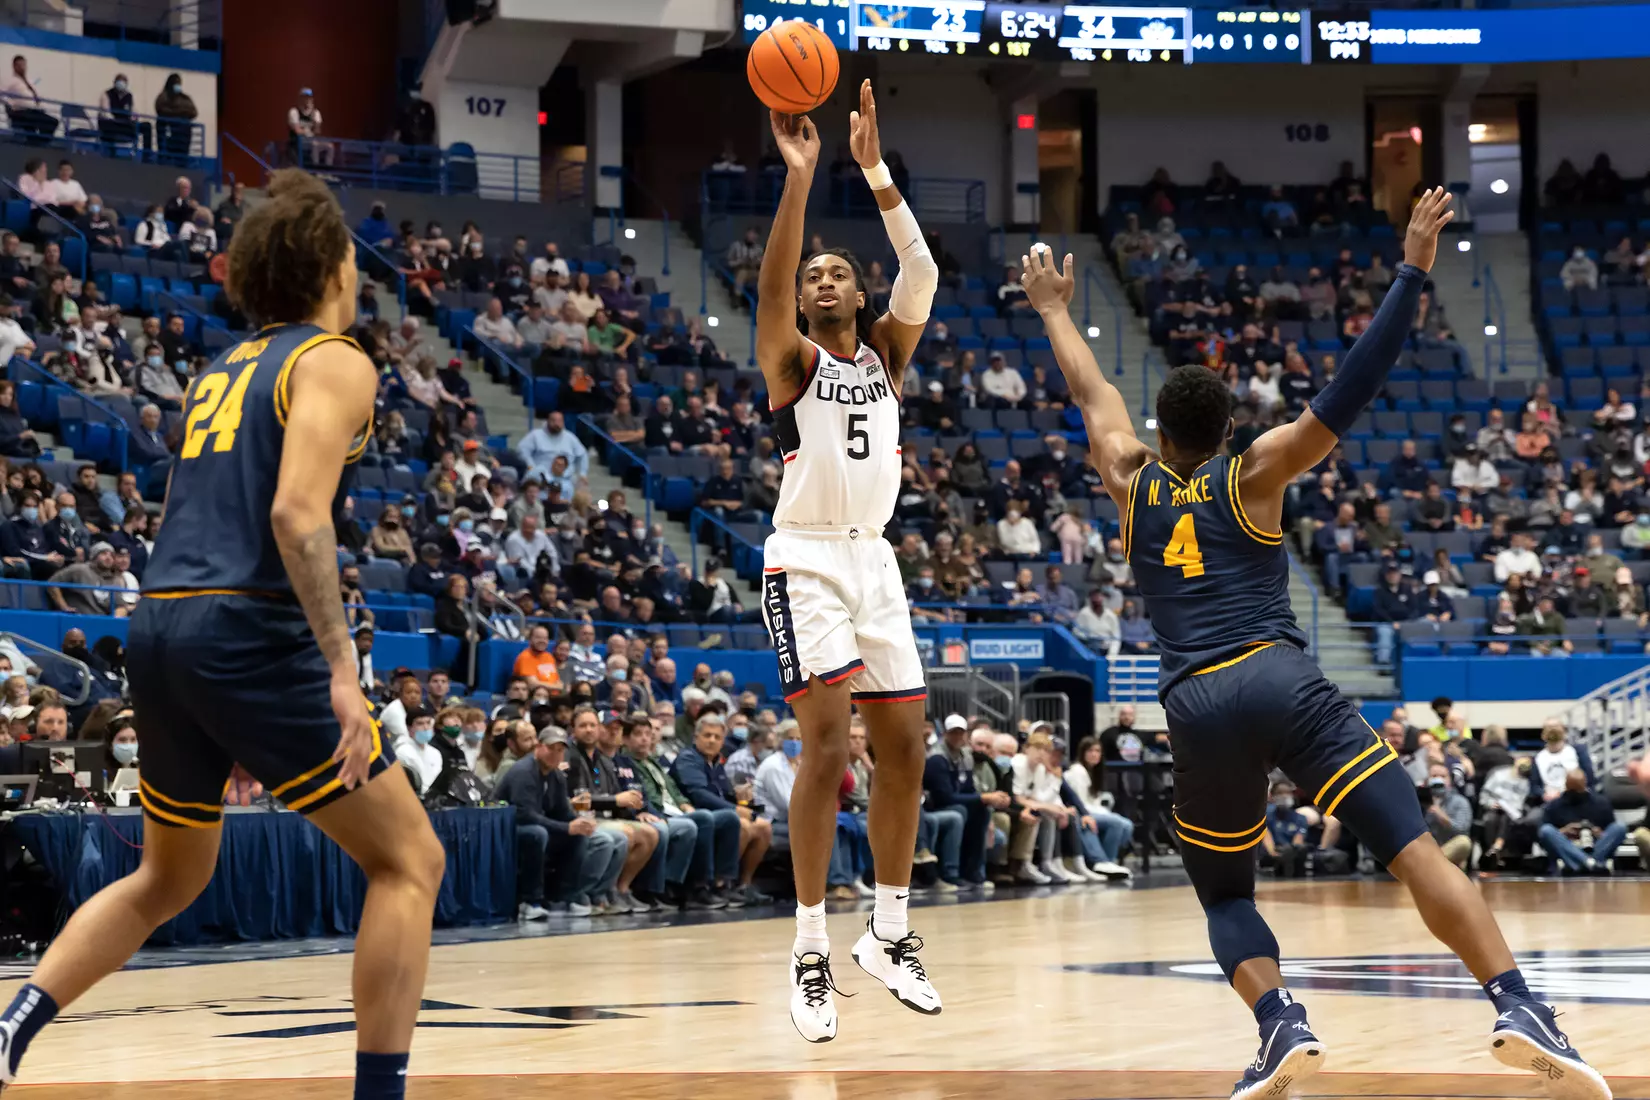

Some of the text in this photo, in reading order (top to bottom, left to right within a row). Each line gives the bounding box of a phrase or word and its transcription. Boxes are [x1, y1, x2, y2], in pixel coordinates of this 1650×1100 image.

[932, 7, 967, 33] 23
[1001, 10, 1057, 38] 6:24
[1078, 14, 1116, 39] 34
[1219, 33, 1234, 50] 0
[1243, 33, 1253, 50] 1
[1262, 33, 1278, 50] 0
[1284, 33, 1300, 50] 0
[1330, 41, 1360, 59] PM
[465, 96, 507, 117] 107
[1284, 123, 1330, 142] 108
[816, 378, 888, 406] UCONN
[181, 361, 258, 459] 24
[847, 413, 870, 461] 5
[1147, 479, 1161, 506] N.
[1163, 512, 1205, 579] 4
[768, 581, 794, 684] HUSKIES
[974, 643, 1040, 655] BUD LIGHT
